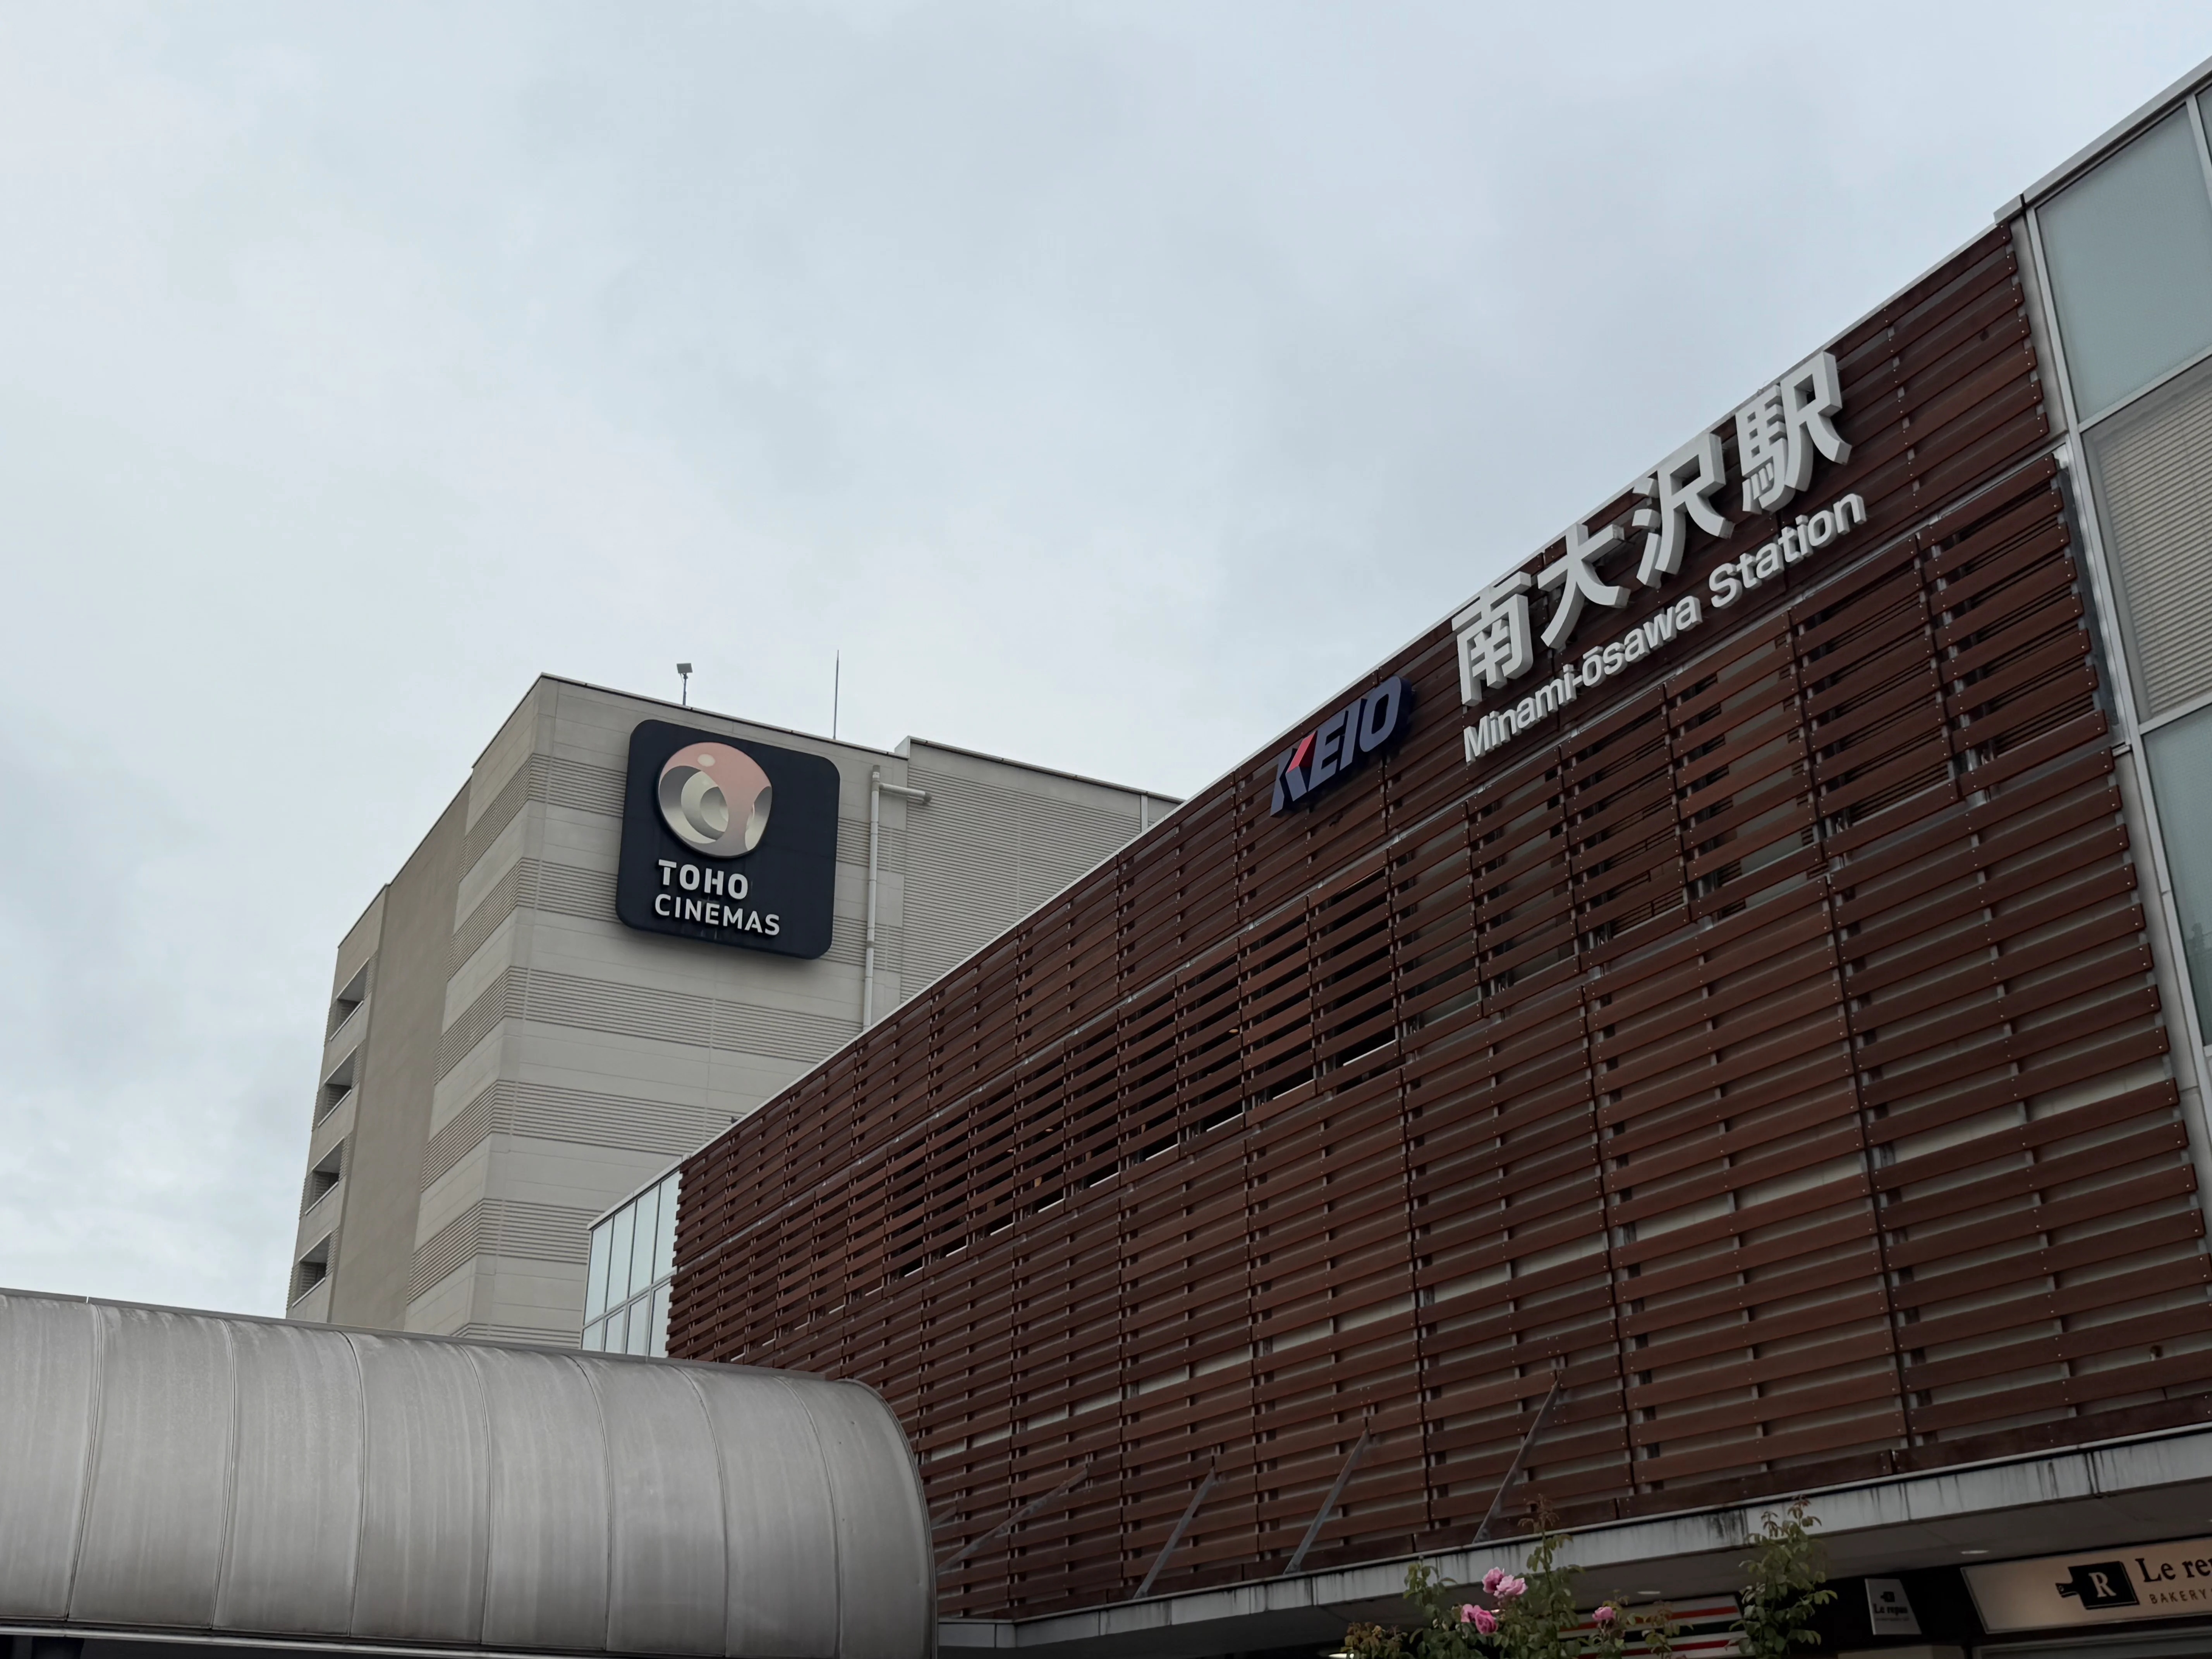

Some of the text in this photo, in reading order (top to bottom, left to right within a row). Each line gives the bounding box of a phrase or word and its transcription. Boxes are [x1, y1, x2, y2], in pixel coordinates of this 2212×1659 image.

[1452, 350, 1852, 706] 南大沢駅
[1709, 493, 1867, 608] Station
[1270, 675, 1411, 817] KEIO
[658, 859, 748, 900] TOHO
[654, 894, 780, 936] CINEMAS
[2088, 1571, 2117, 1598] R
[2135, 1558, 2212, 1582] Le re
[2149, 1589, 2207, 1604] BAKERY
